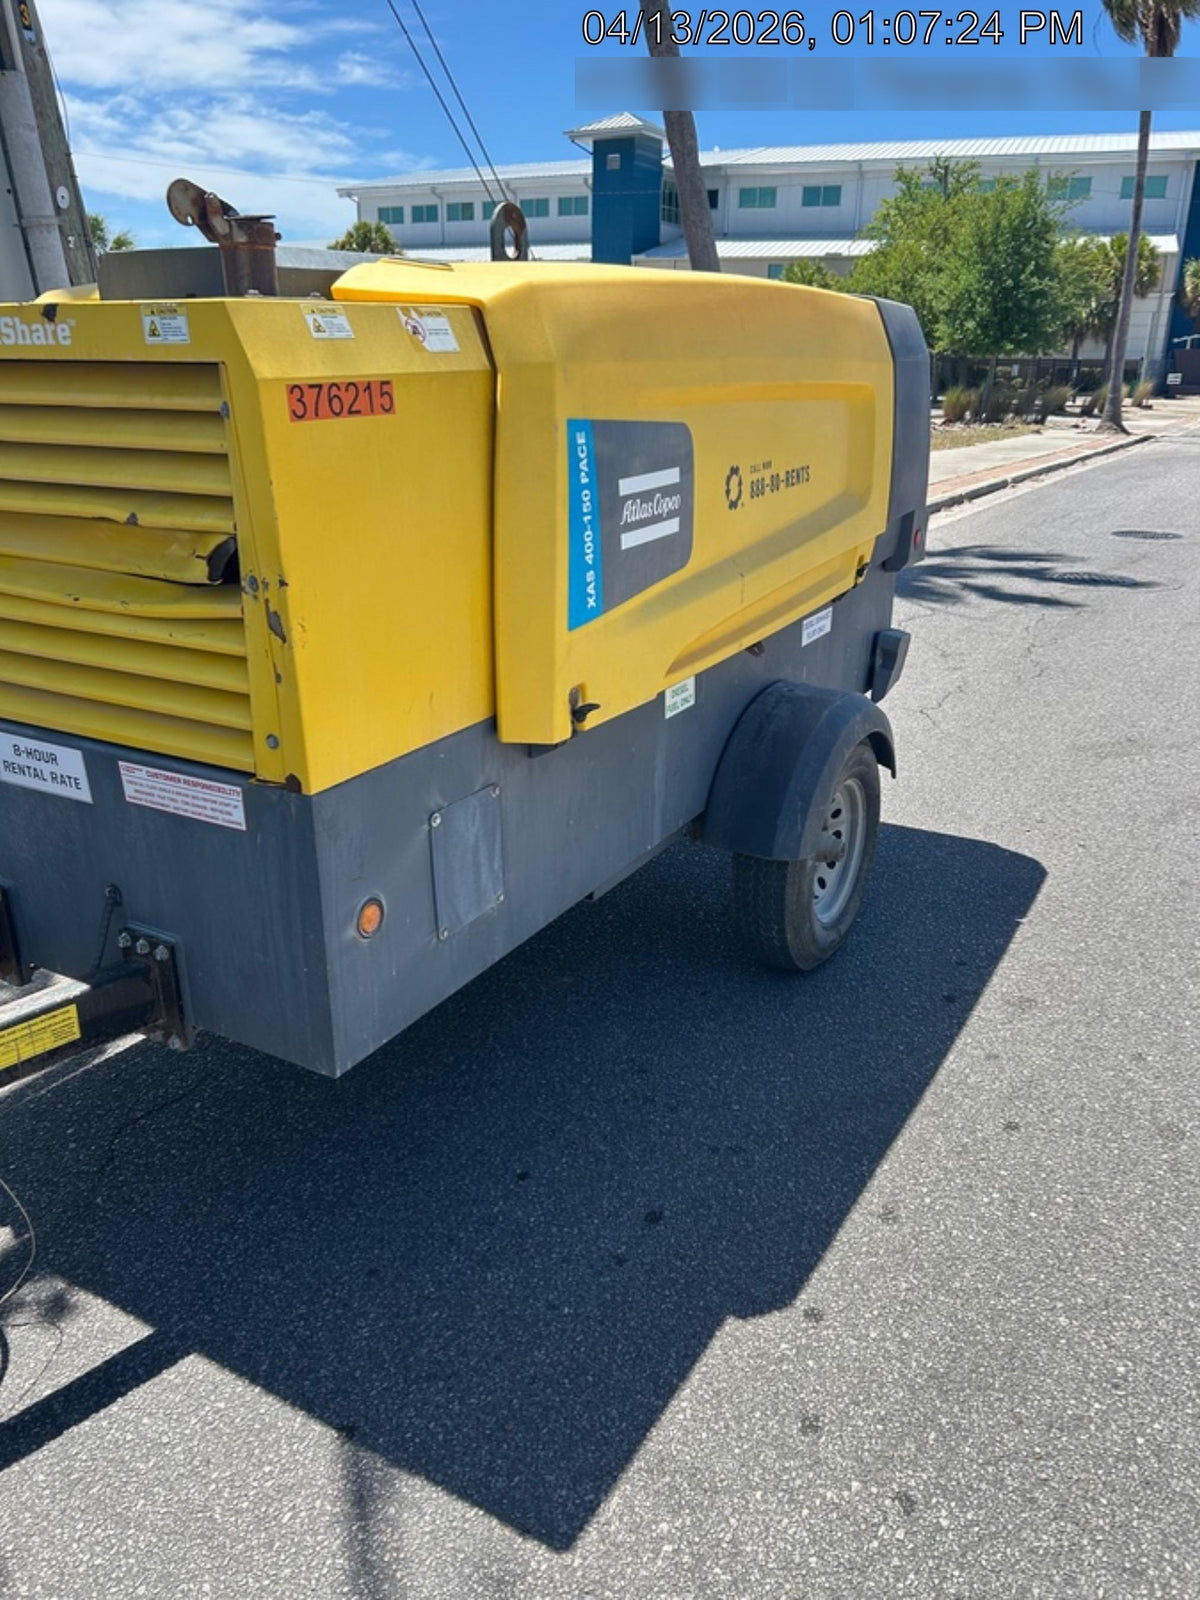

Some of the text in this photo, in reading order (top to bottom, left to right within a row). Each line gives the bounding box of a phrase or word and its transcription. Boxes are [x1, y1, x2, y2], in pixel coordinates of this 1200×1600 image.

[20, 3, 30, 27] 3
[290, 380, 394, 420] 376215
[750, 464, 810, 500] 888-80-RENTS
[576, 431, 597, 608] XAS 400-150 PACE
[620, 493, 682, 525] Atlas Copco
[13, 744, 59, 767] 8-HOUR
[2, 760, 83, 790] RENTAL RATE
